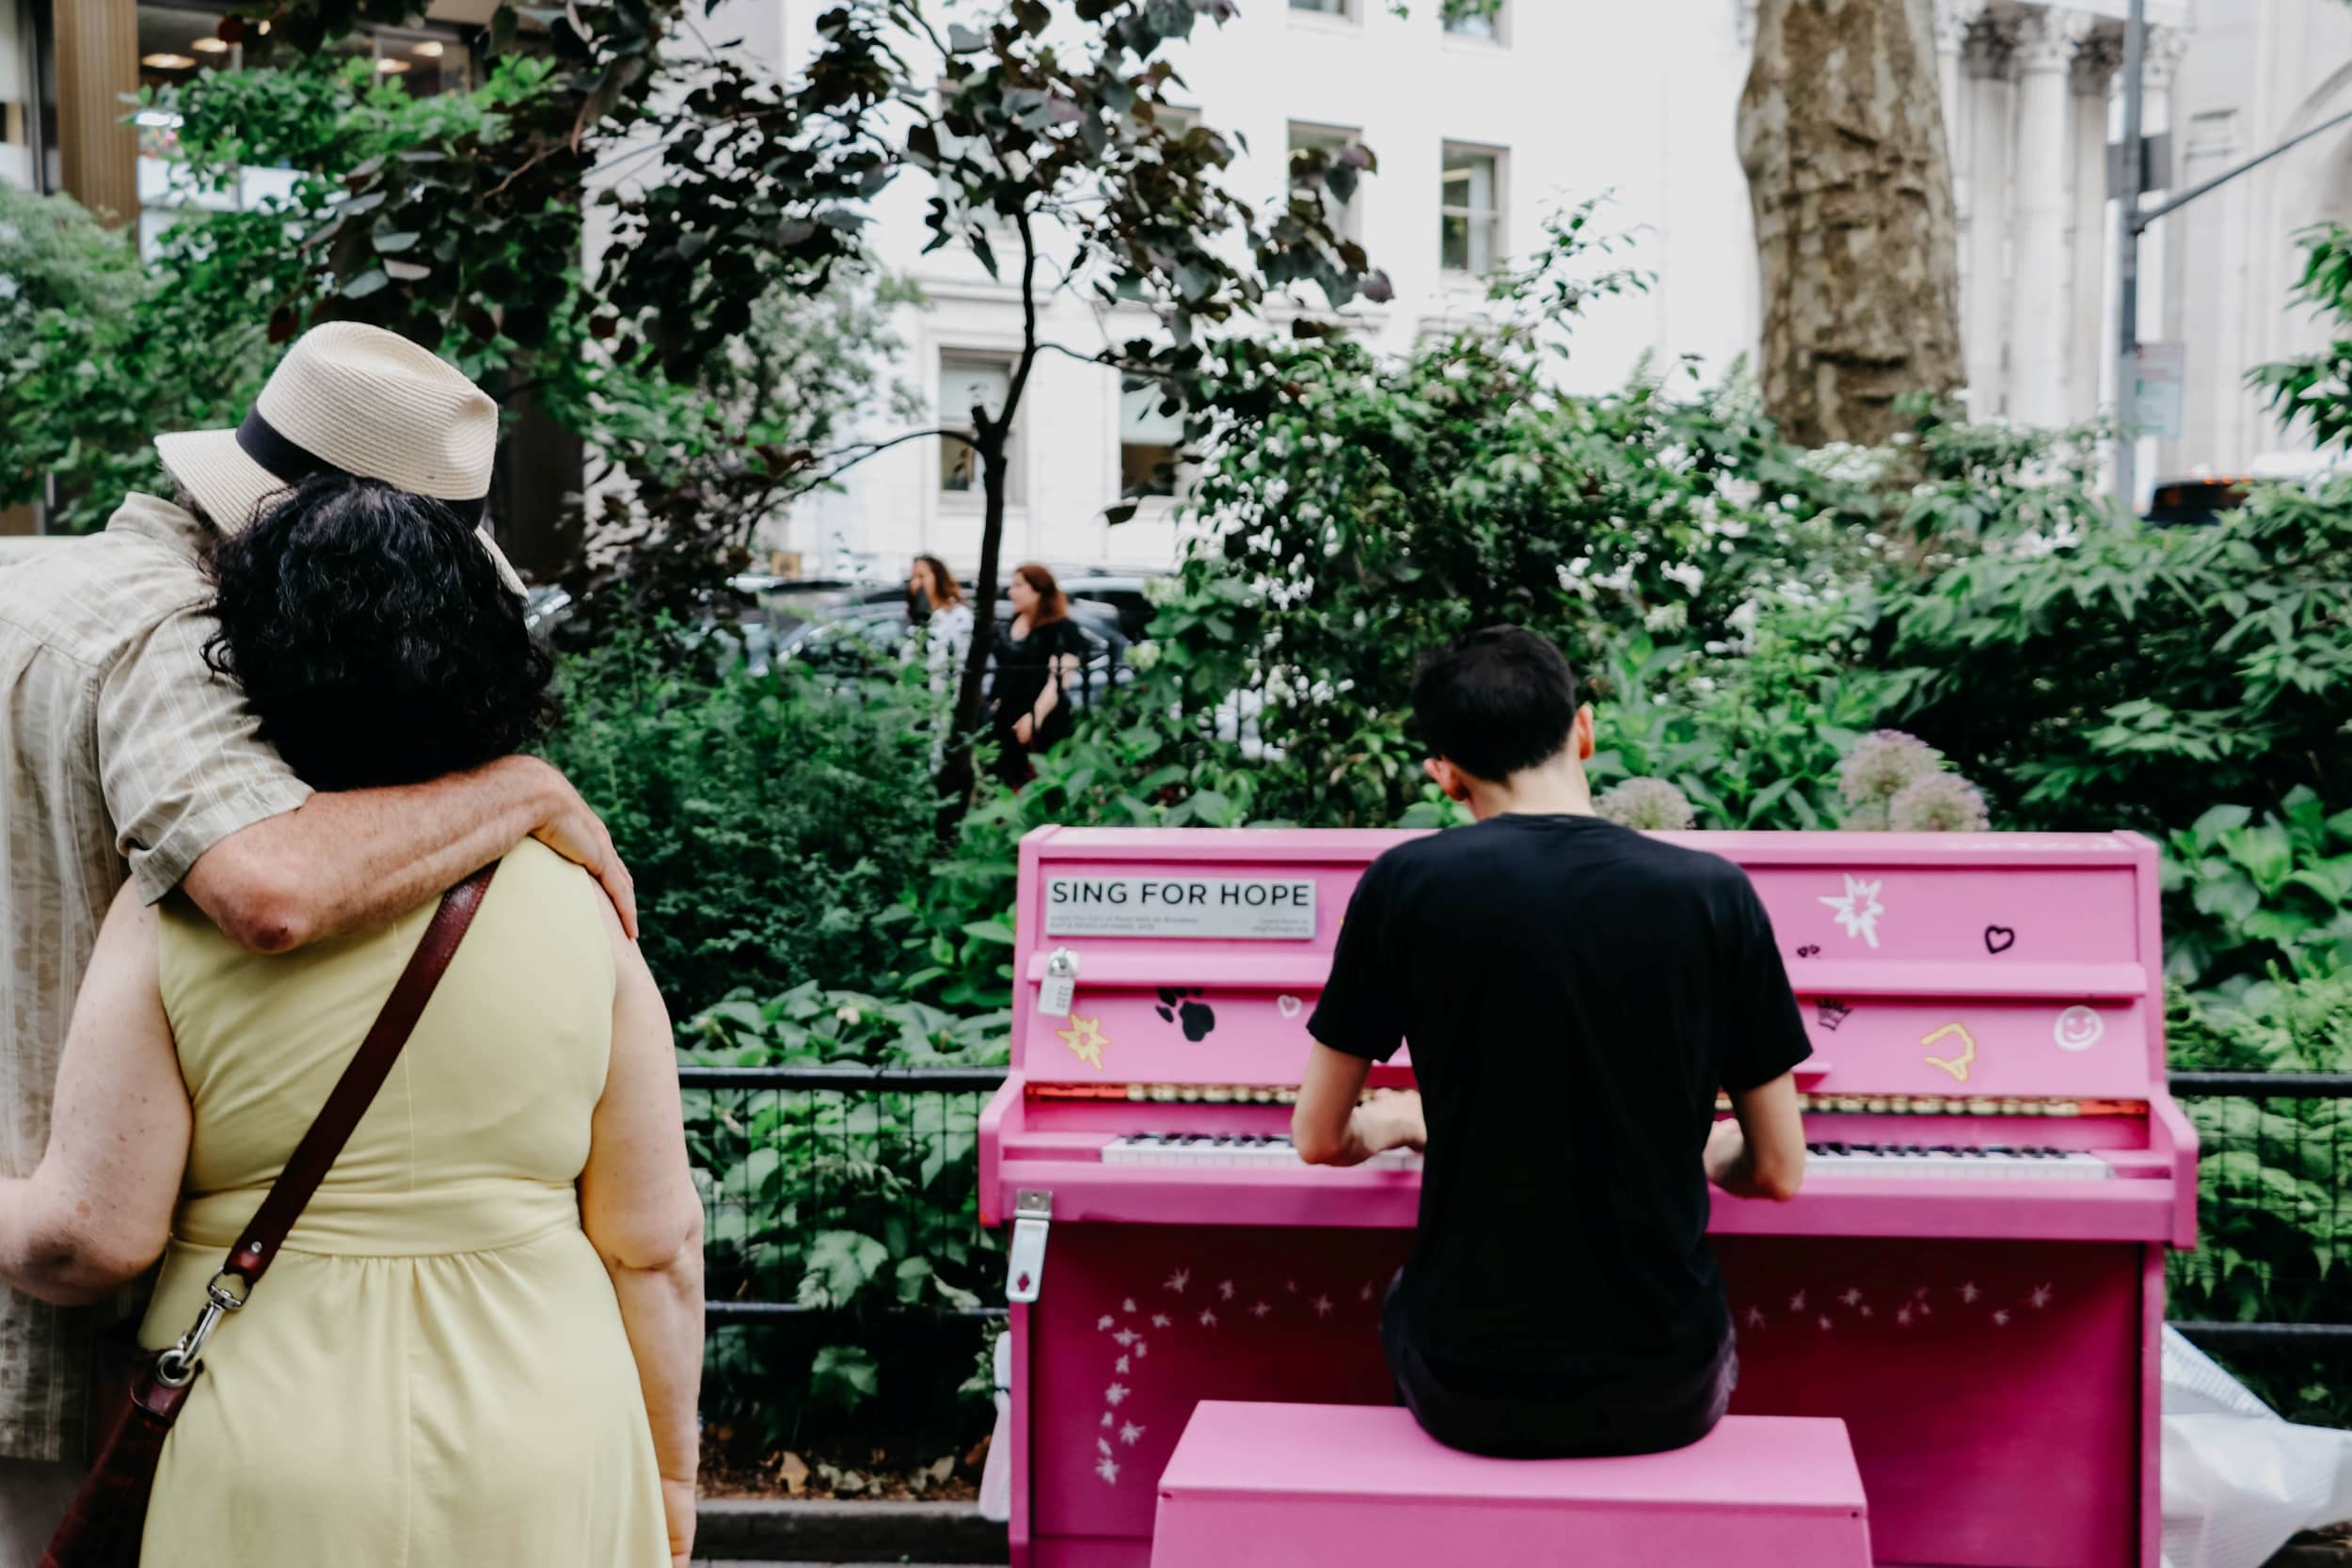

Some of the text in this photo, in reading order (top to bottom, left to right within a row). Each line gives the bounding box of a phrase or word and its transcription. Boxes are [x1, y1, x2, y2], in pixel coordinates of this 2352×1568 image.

[1052, 880, 1310, 907] SING FOR HOPE
